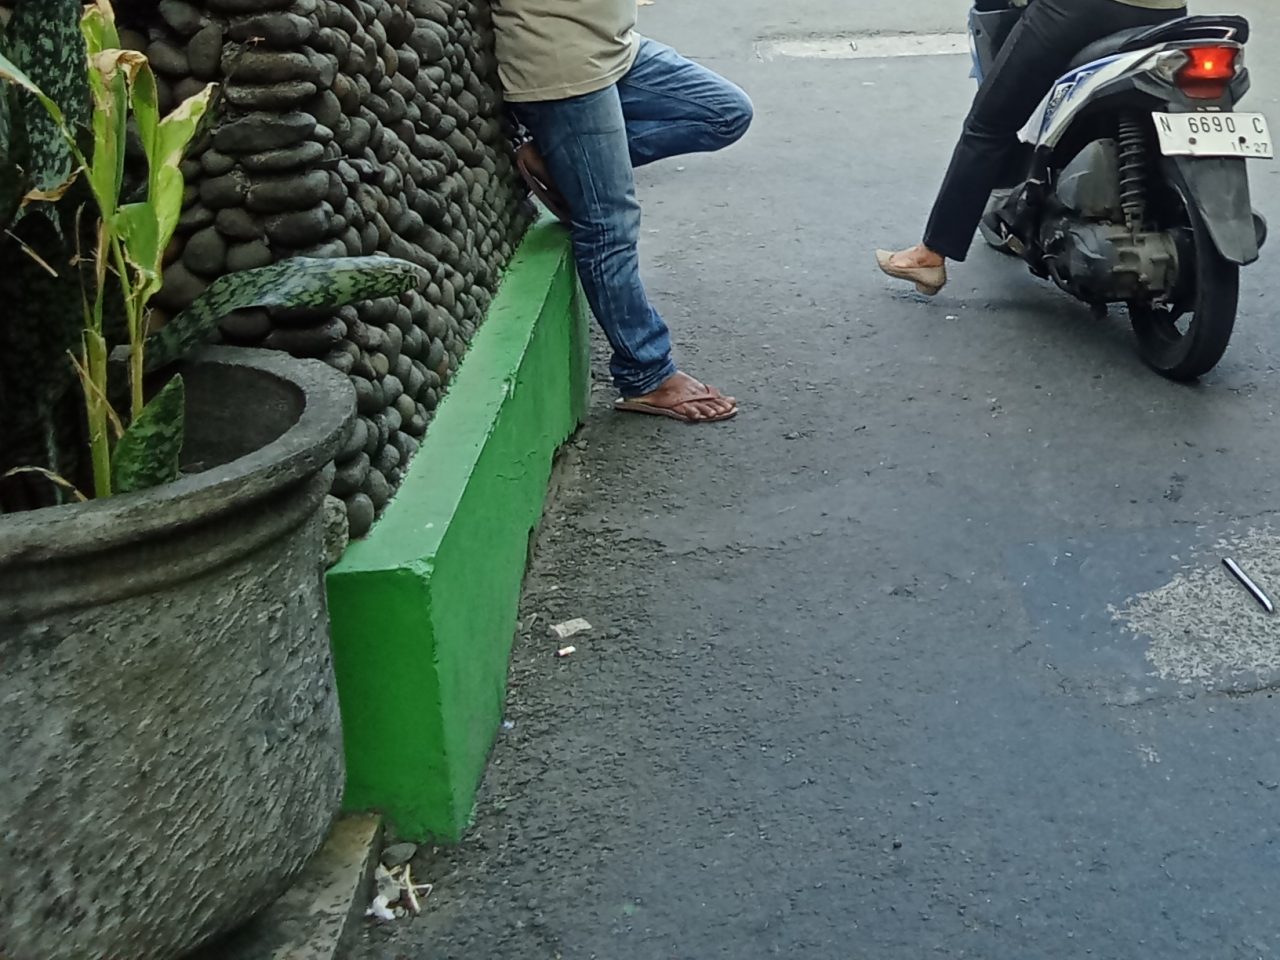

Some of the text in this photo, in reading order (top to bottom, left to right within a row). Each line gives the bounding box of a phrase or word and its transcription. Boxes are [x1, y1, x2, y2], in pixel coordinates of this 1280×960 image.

[1160, 116, 1264, 134] N 6690 C
